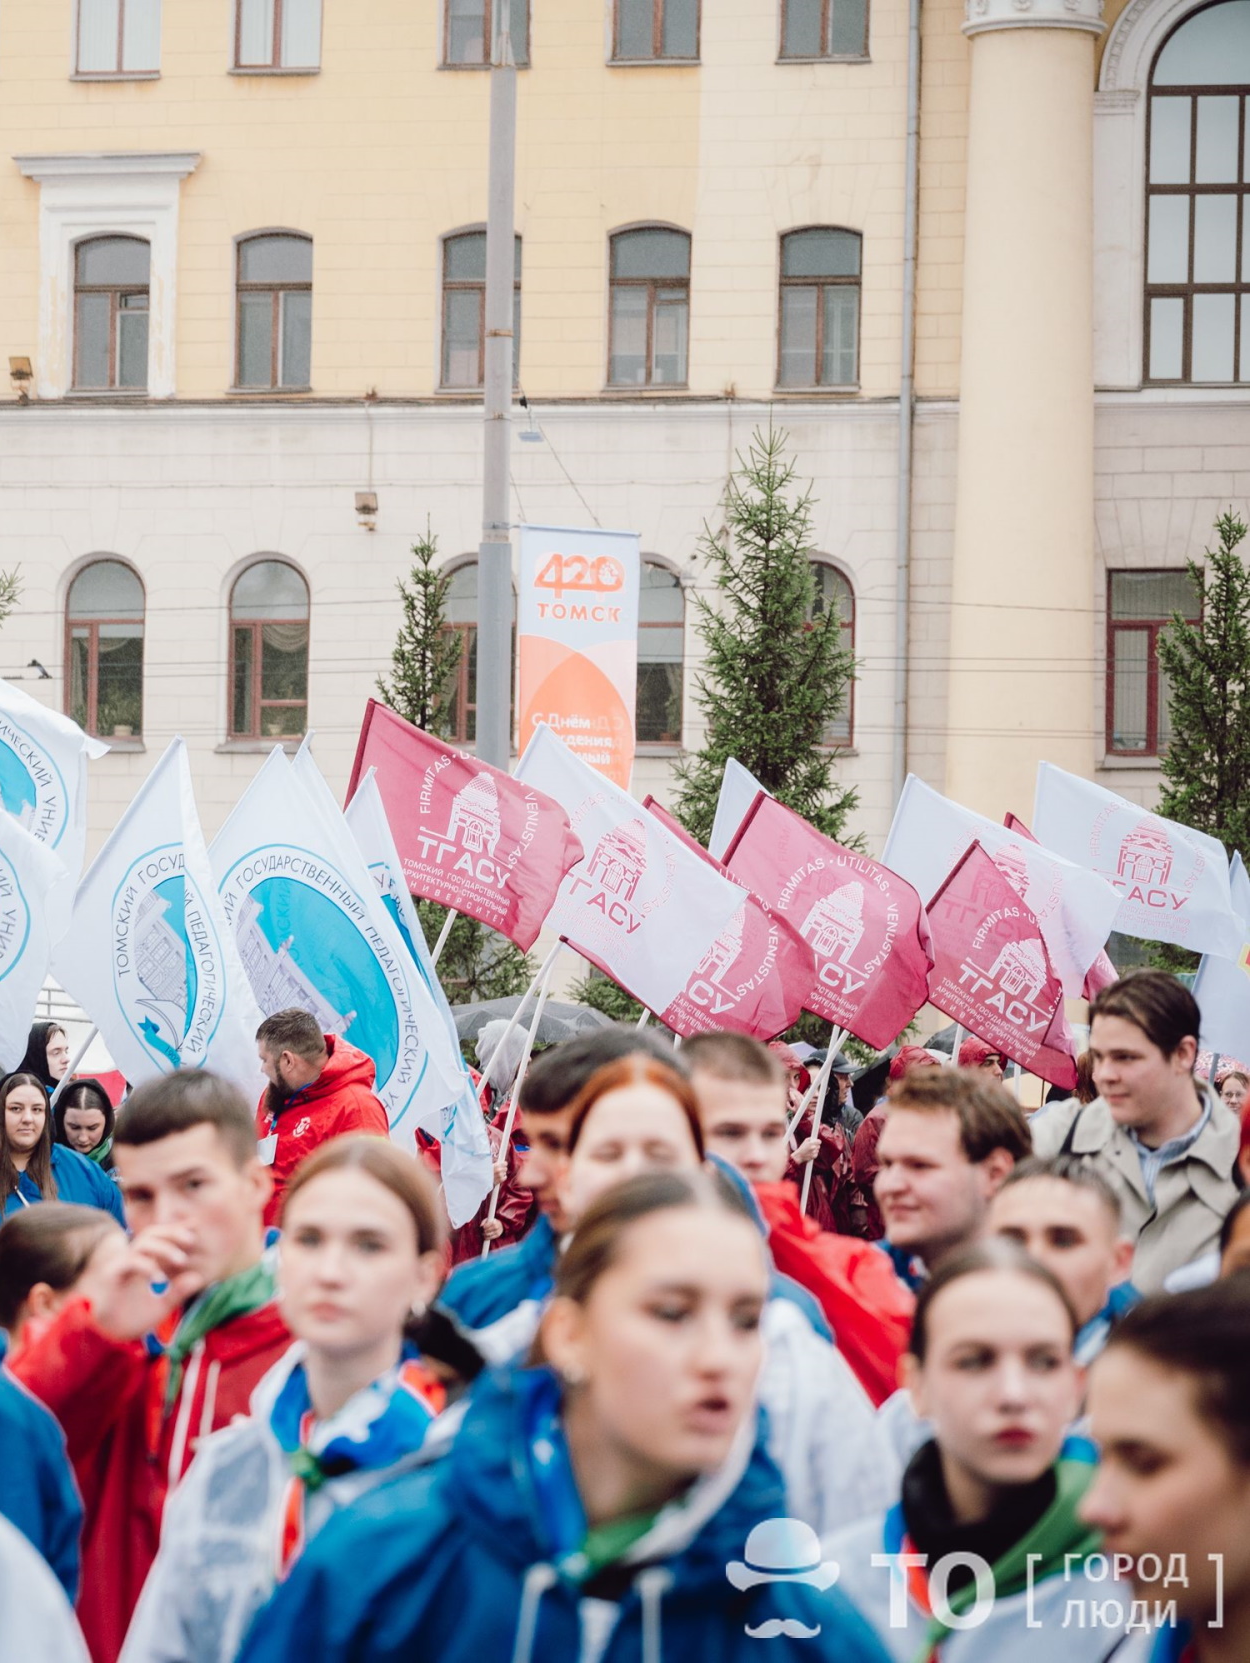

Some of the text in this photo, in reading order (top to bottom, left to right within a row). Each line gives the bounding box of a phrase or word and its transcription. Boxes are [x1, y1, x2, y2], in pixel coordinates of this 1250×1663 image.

[533, 553, 625, 600] 420
[536, 602, 623, 623] ТОМСК
[548, 712, 590, 730] Днём
[419, 754, 539, 869] FIRMITAS VENUSTAS
[403, 857, 511, 907] ТОМСКИЙ ГОСУДАРСТВЕННЫЙ
[417, 835, 511, 889] ТГАСУ
[777, 857, 825, 910] FIRMITAS
[837, 855, 889, 892] UTILITAS
[864, 902, 899, 973] VENUSTAS
[972, 906, 1019, 950] FIRMITAS
[115, 886, 138, 978] ТОМСКИЙ
[186, 908, 218, 1054] ПЕДАГОГИЧЕСКИЙ
[235, 854, 366, 921] ГОСУДАРСТВЕННЫЙ
[365, 925, 420, 1084] ПЕДАГОГИЧЕСКИЙ
[735, 925, 779, 997] VENUSTAS
[935, 984, 1037, 1057] АРХИТЕКТУРНО-СТРОИТЕЛЬНЫЙ
[941, 976, 1042, 1051] ТОМСКИЙ ГОСУДАРСТВЕННЫЙ
[958, 963, 1049, 1033] ТГАСУ
